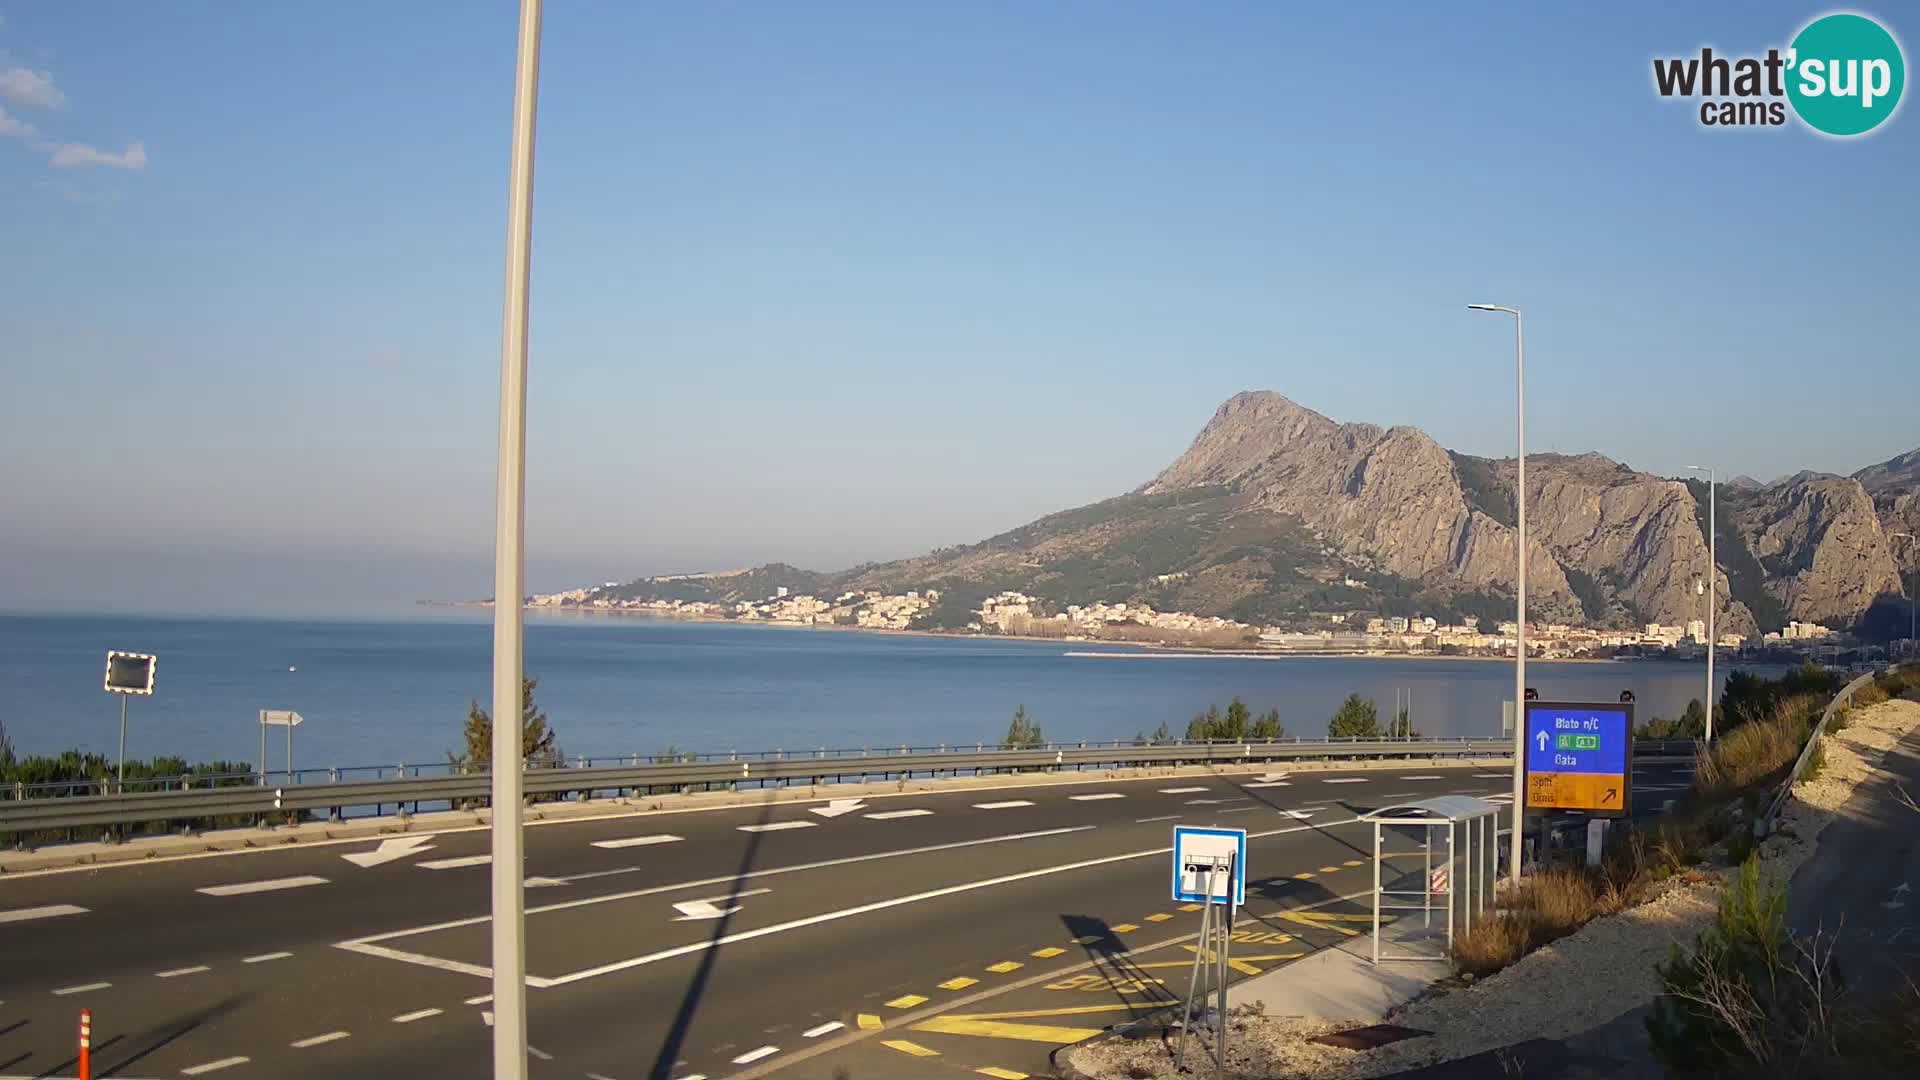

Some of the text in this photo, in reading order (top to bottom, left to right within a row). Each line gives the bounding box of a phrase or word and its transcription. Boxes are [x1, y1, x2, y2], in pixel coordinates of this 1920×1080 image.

[1555, 716, 1600, 731] Blato n/C
[1555, 754, 1577, 766] Gata
